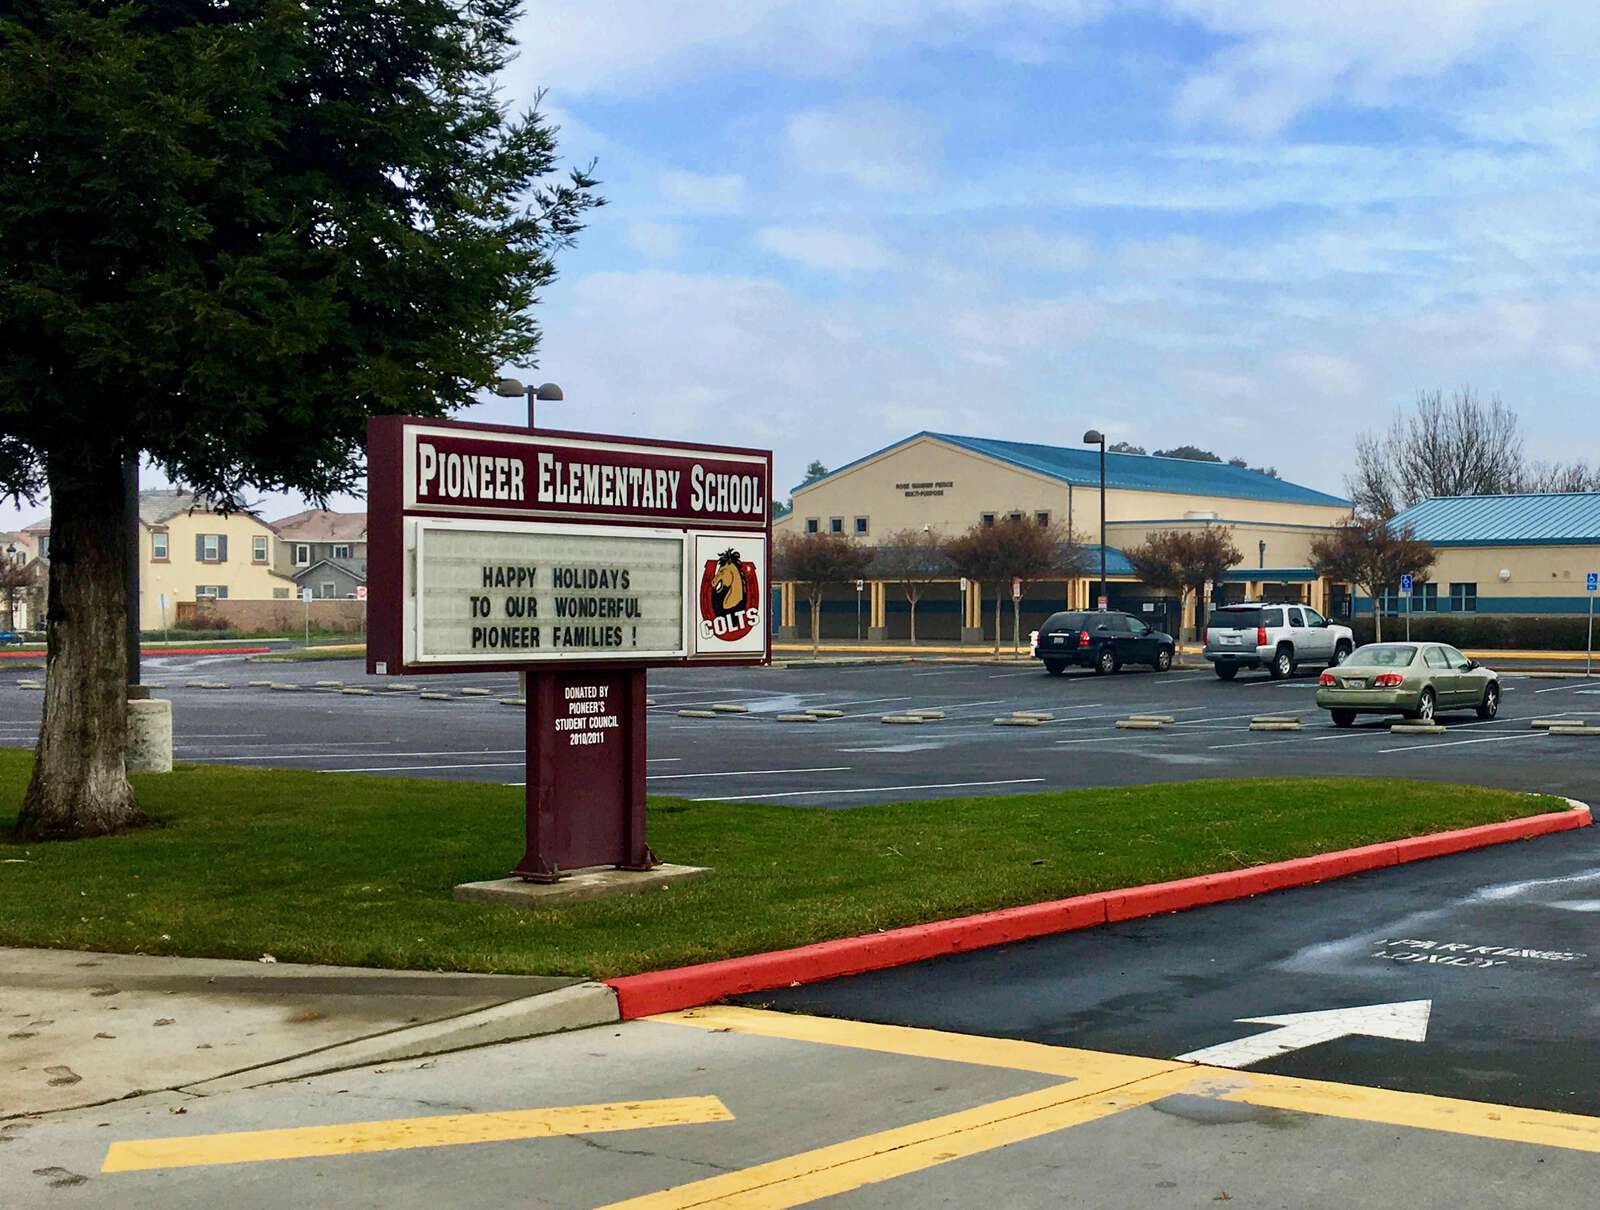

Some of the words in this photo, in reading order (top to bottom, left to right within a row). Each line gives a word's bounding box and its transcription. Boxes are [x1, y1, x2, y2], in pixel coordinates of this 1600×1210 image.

[418, 442, 525, 501] PIONEER
[538, 452, 681, 510] ELEMENTARY
[690, 463, 763, 515] SCHOOL
[482, 566, 537, 588] HAPPY
[553, 567, 631, 590] HOLIDAYS
[469, 596, 491, 618] TO
[505, 596, 538, 618] OUR
[554, 596, 642, 619] WONDERFUL
[700, 607, 760, 640] COLTS
[471, 626, 540, 649] PIONEER
[552, 626, 623, 648] FAMILIES
[564, 685, 597, 700] DONATED
[598, 685, 609, 698] BY
[568, 700, 606, 715] PIONEER'S
[555, 717, 587, 731] STUDENT
[588, 715, 619, 729] COUNCIL
[569, 731, 605, 746] 2010/2011
